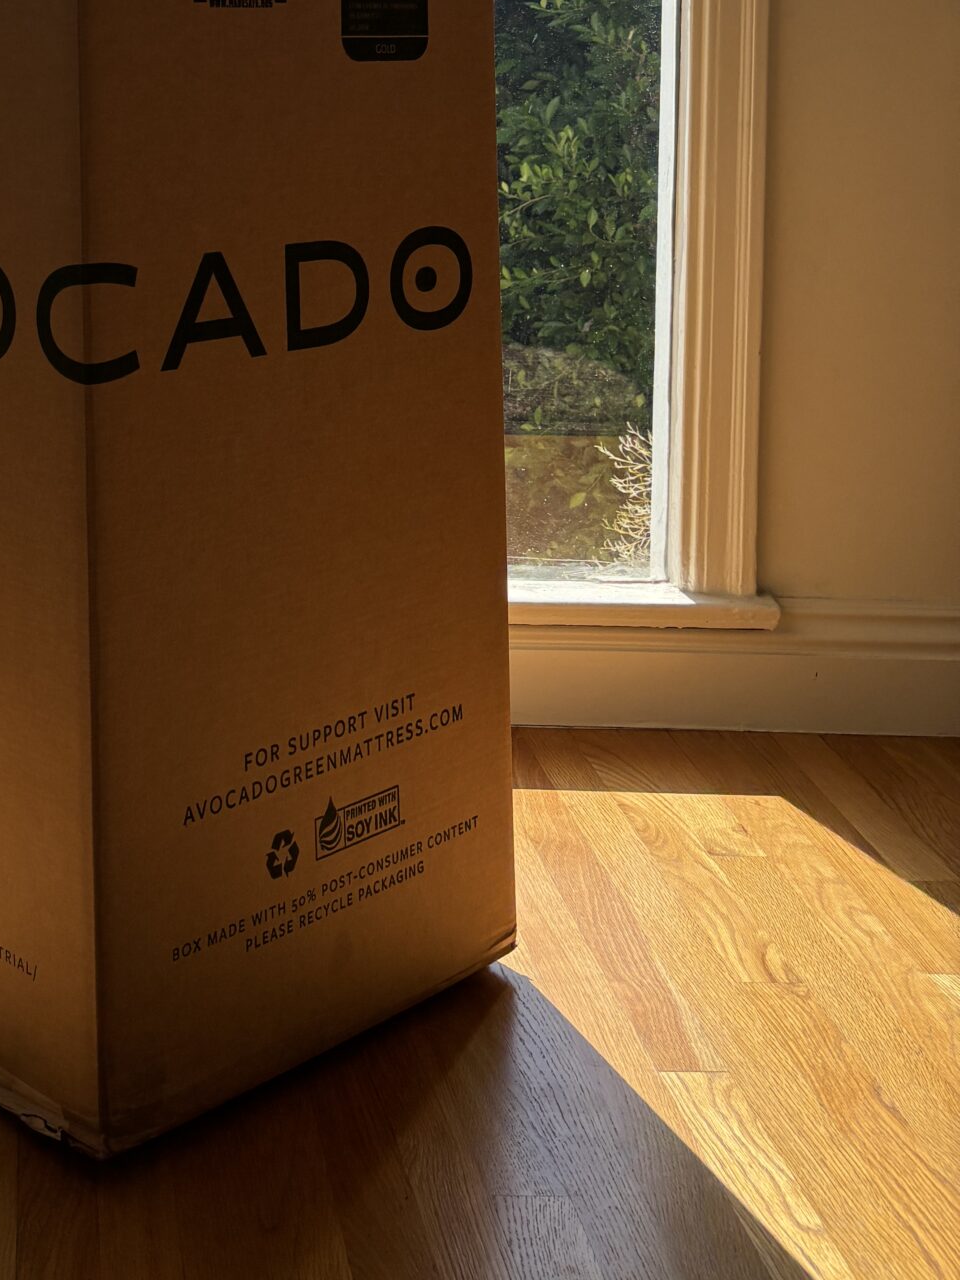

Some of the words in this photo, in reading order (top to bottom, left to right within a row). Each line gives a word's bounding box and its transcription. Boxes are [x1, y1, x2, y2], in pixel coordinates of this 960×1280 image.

[183, 704, 464, 826] AVOCADOGREENMATTRESS.COM
[244, 745, 280, 771] FOR
[288, 712, 367, 755] SUPPORT
[375, 693, 416, 722] VISIT
[345, 800, 376, 820] PRINTED
[378, 791, 397, 807] WITH
[347, 816, 372, 841] SOY
[375, 805, 397, 830] INK
[172, 938, 202, 962] BOX
[207, 919, 246, 946] MADE
[251, 902, 287, 927] WITH
[291, 889, 317, 912] 50%
[321, 841, 423, 896] POST-CONSUMER
[428, 815, 479, 849] CONTENT
[245, 920, 293, 953] PLEASE
[299, 893, 354, 929] RECYCLE
[358, 861, 425, 902] PACKAGING
